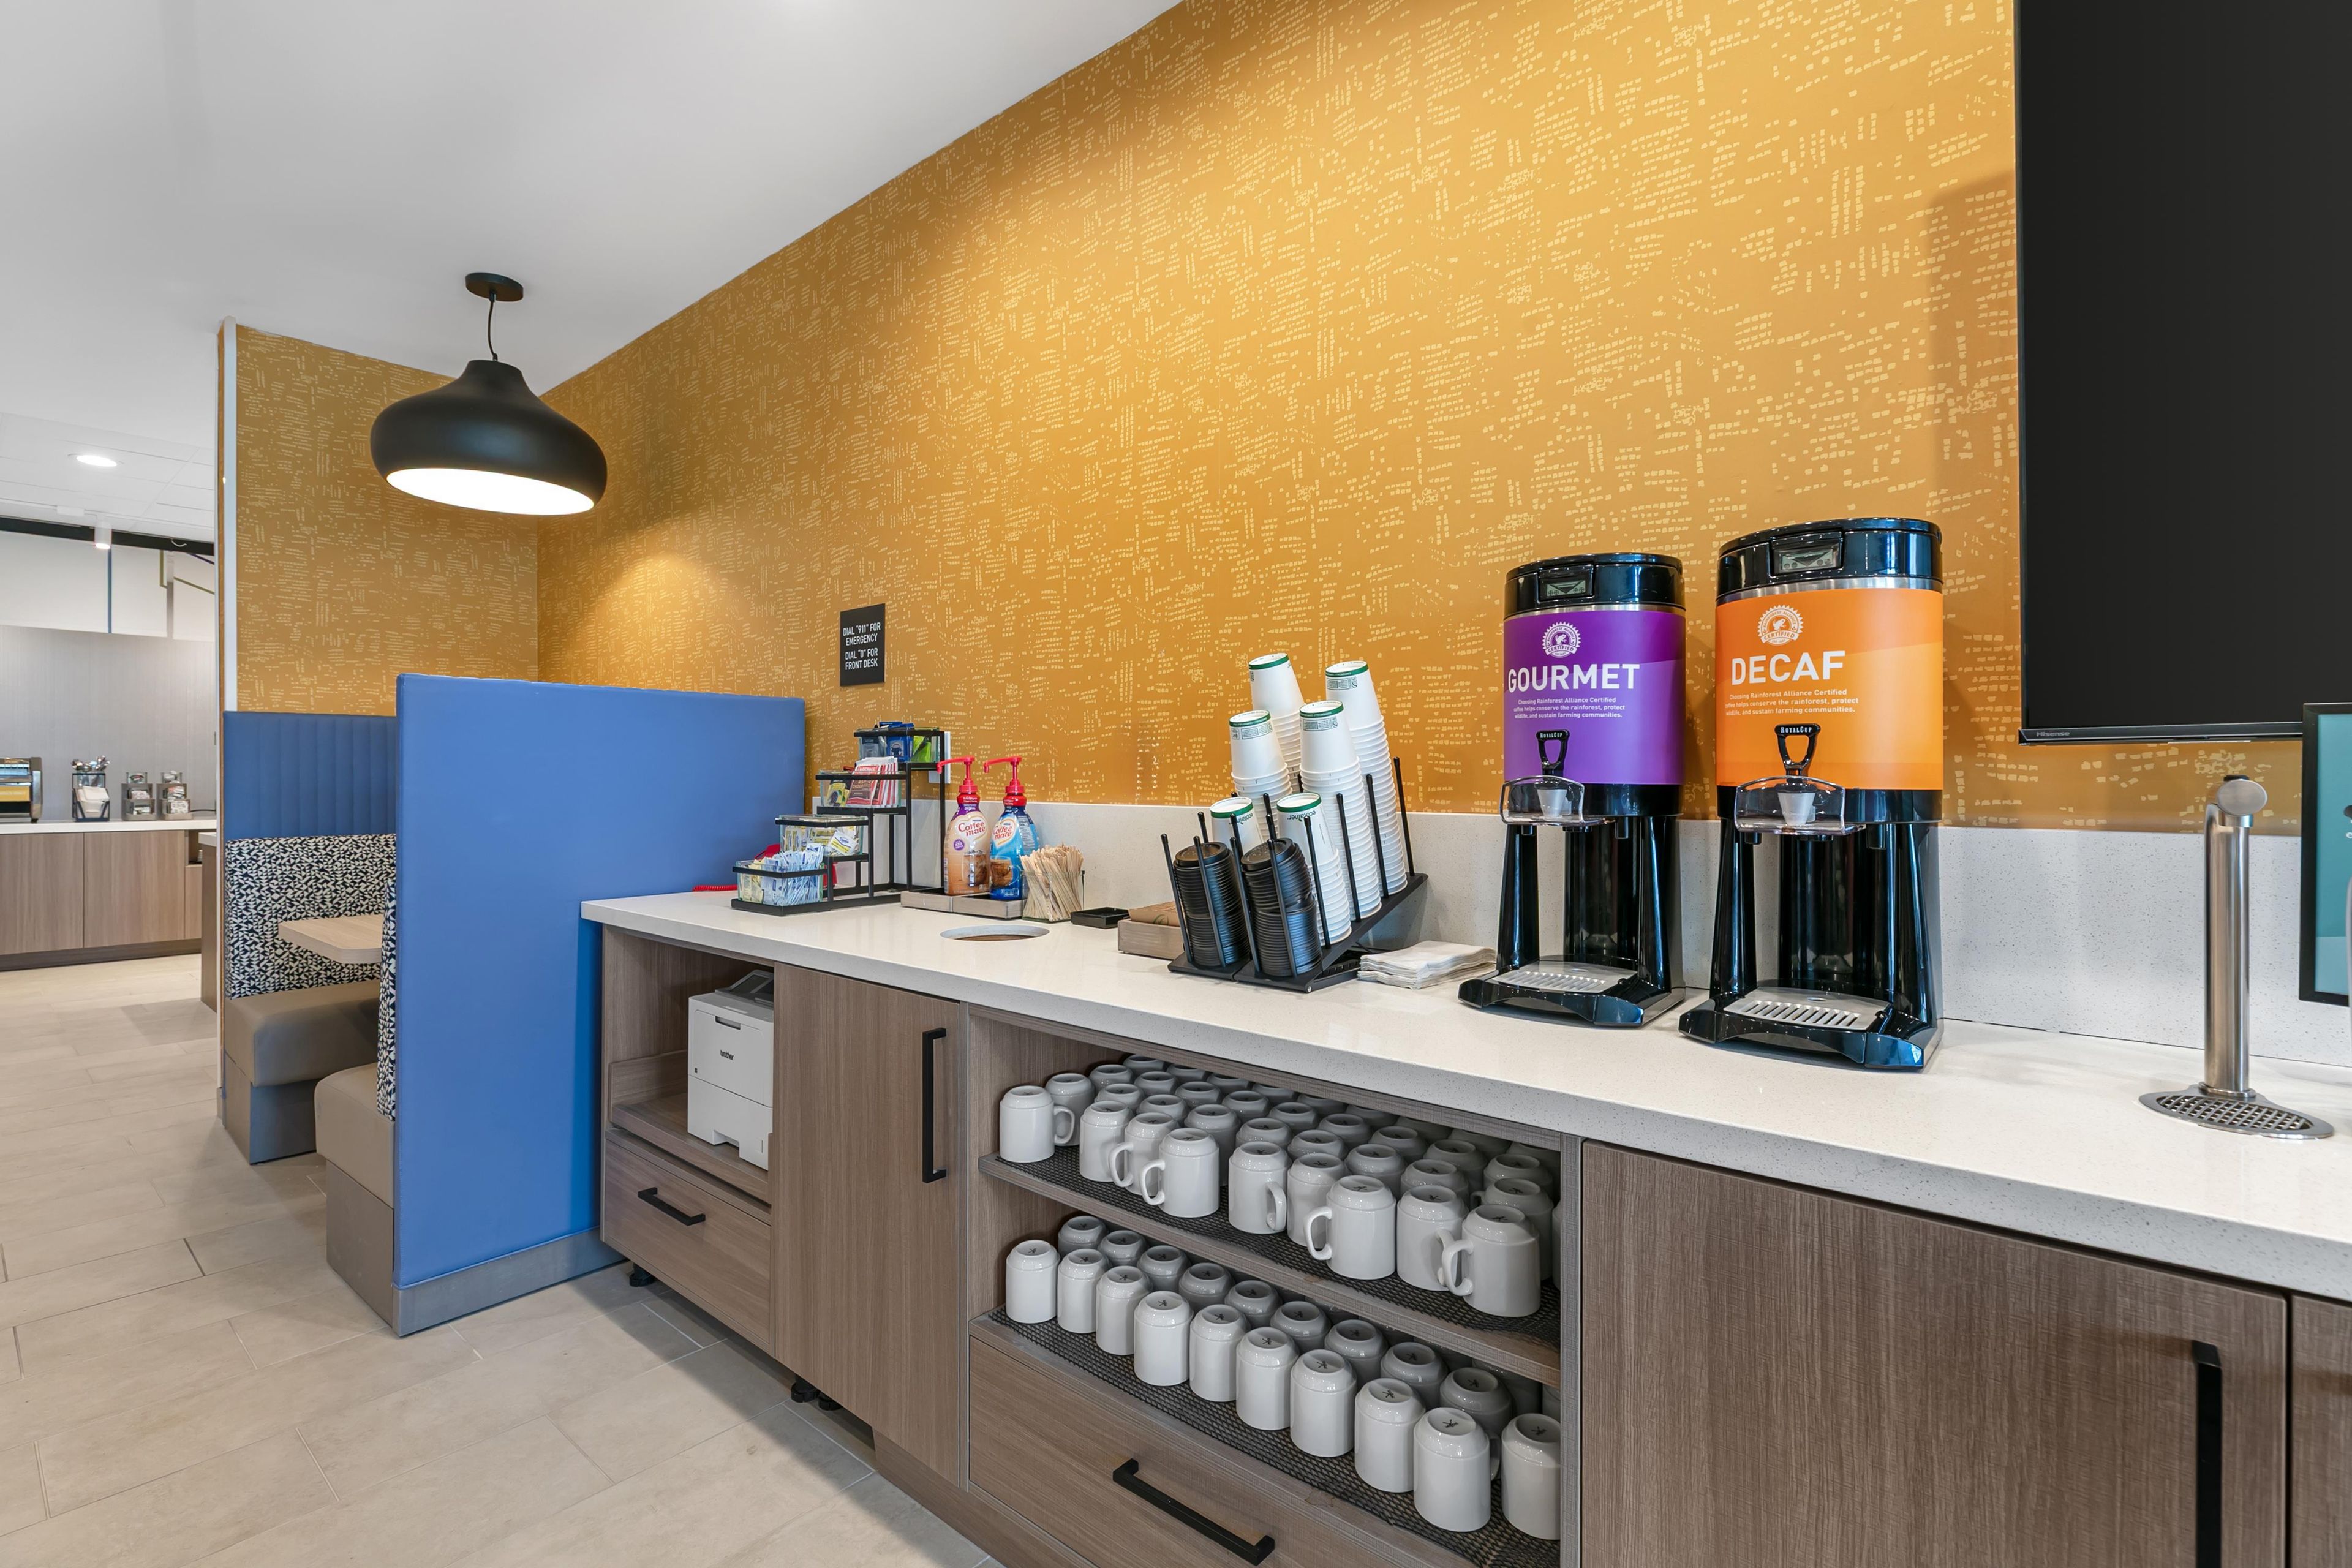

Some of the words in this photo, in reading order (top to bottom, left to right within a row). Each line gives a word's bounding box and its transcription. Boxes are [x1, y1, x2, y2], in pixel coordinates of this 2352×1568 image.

[843, 627, 854, 636] DIAL
[870, 622, 881, 631] FOR
[846, 633, 878, 646] EMERGENCY
[1764, 631, 1795, 640] CERTIFIED
[845, 650, 857, 660] DIAL
[867, 647, 878, 657] FOR
[845, 660, 862, 670] FRONT
[864, 658, 878, 668] DESK
[1732, 650, 1845, 685] DECAF
[1508, 663, 1640, 693] GOURMET
[958, 822, 984, 832] Coffee
[966, 827, 985, 836] mate
[993, 826, 1012, 835] Coffee
[720, 1049, 734, 1060] brother
